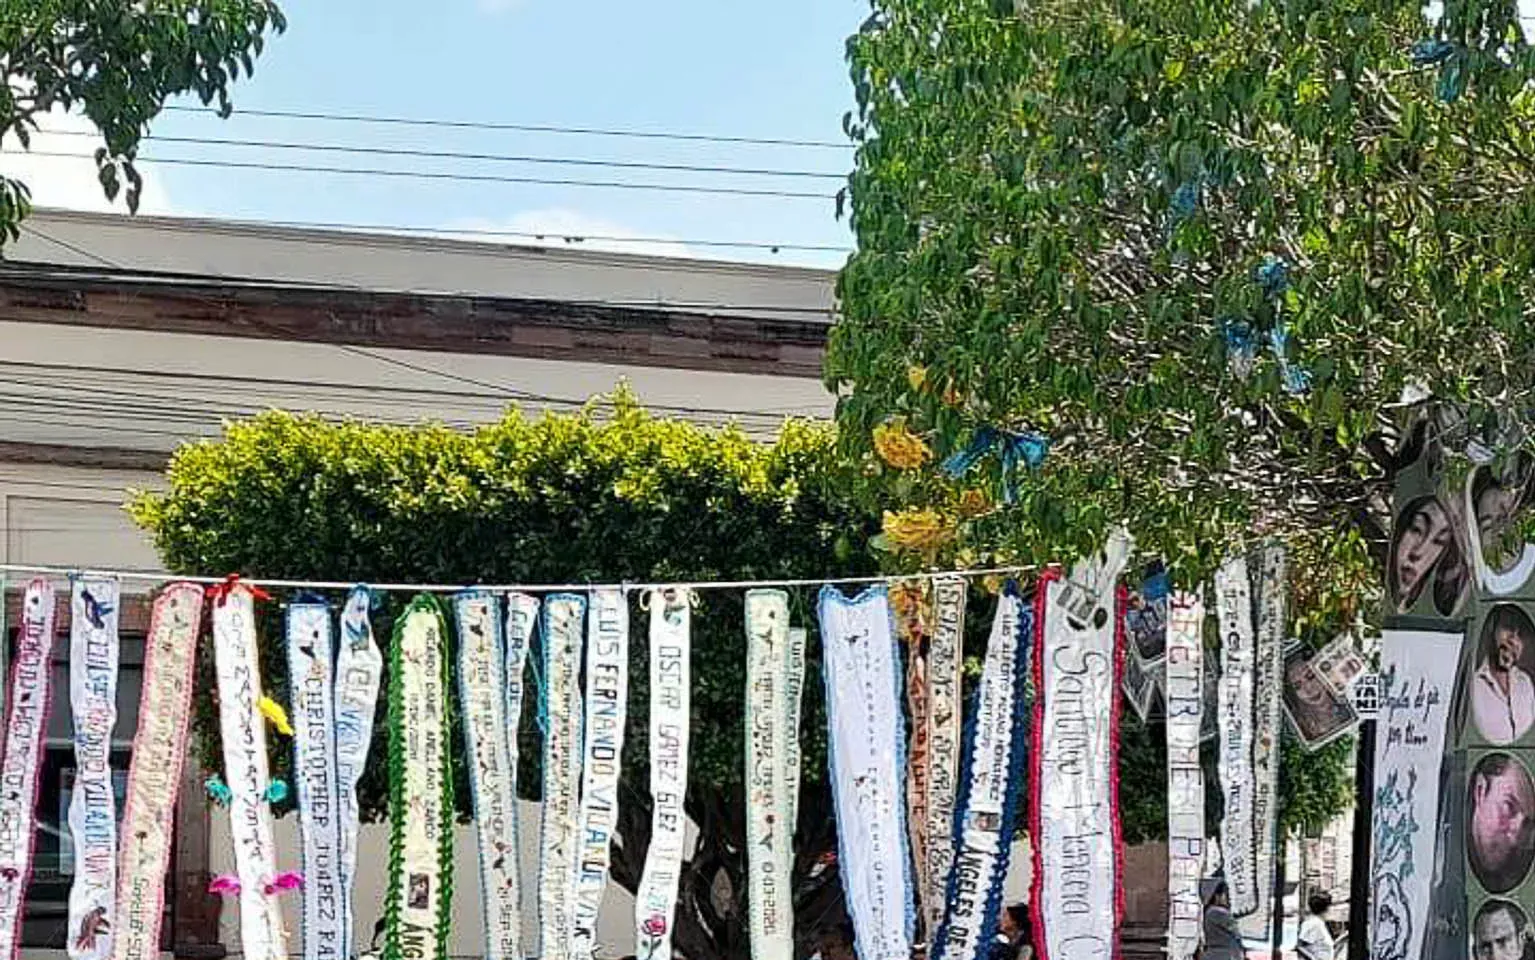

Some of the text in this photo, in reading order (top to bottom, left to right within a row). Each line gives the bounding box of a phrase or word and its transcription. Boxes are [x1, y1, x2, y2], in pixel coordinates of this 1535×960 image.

[596, 608, 619, 657] LUIS
[658, 645, 682, 711] OSCAR
[304, 677, 329, 829] CHRISTOPHER
[951, 844, 998, 918] ÁNGELES
